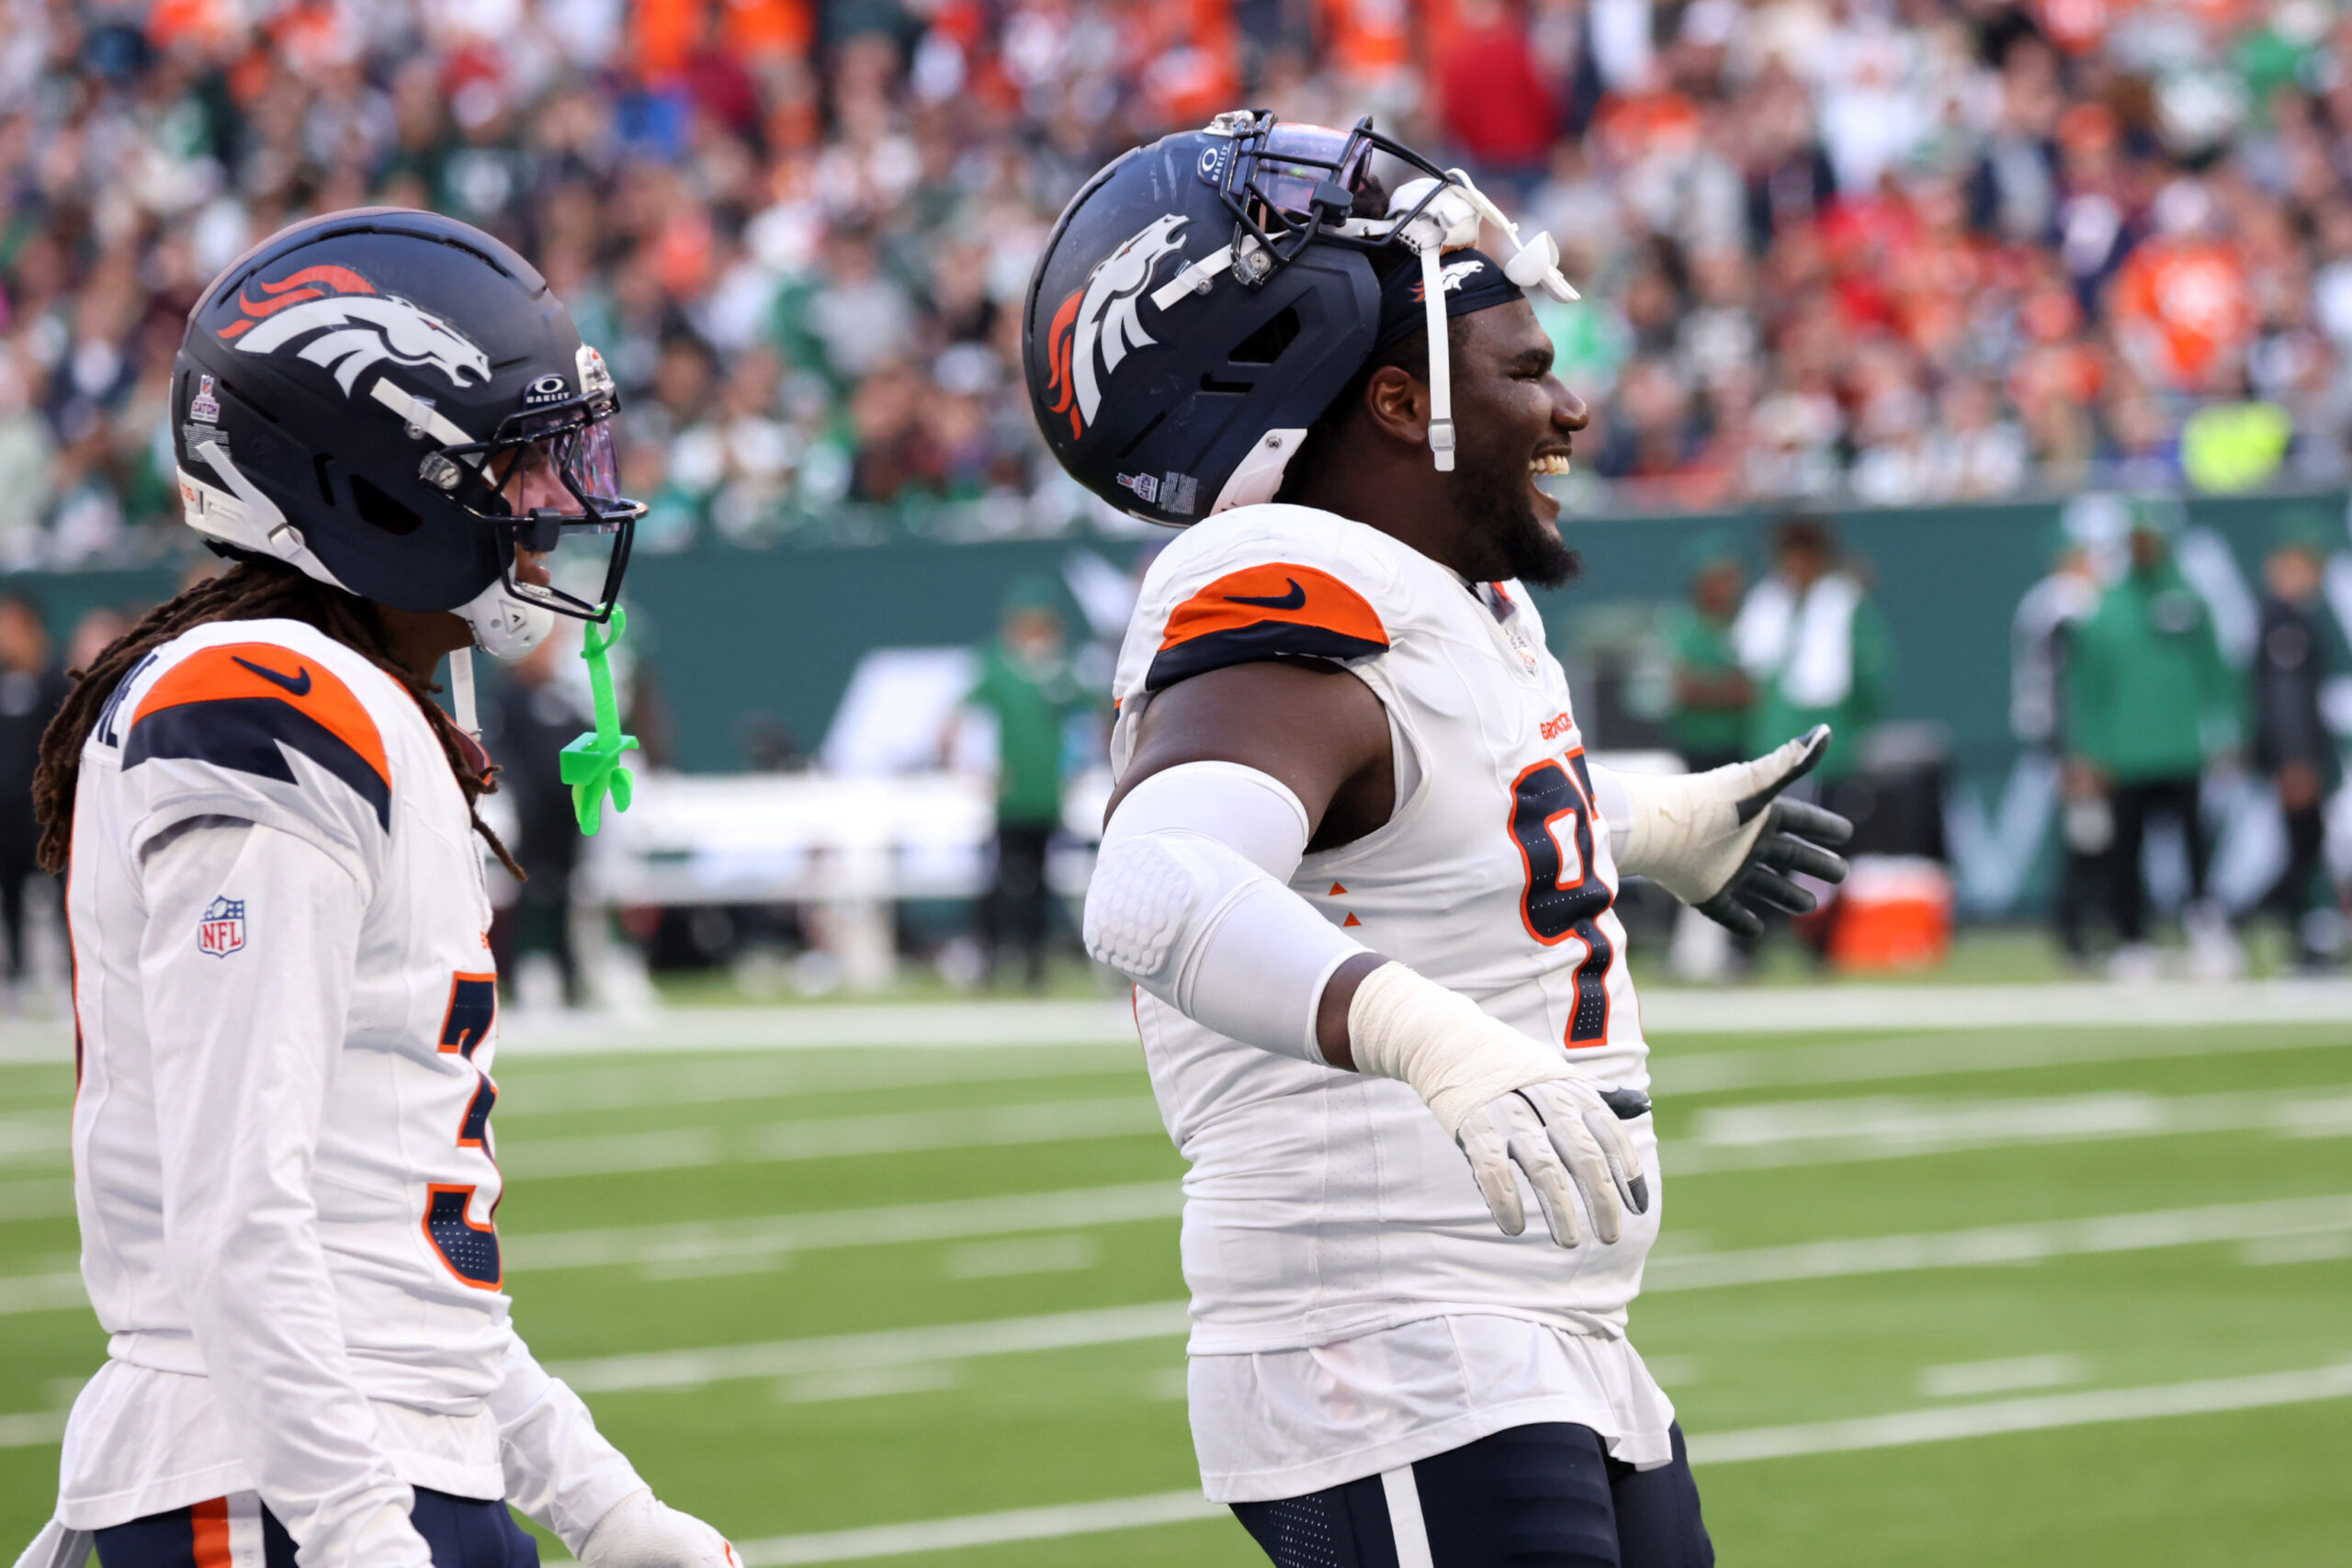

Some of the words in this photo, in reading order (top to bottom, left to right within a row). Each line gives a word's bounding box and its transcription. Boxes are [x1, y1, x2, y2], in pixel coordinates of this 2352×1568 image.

[1211, 144, 1228, 182] OAKLEY
[526, 391, 570, 404] OAKLEY
[202, 921, 242, 951] NFL
